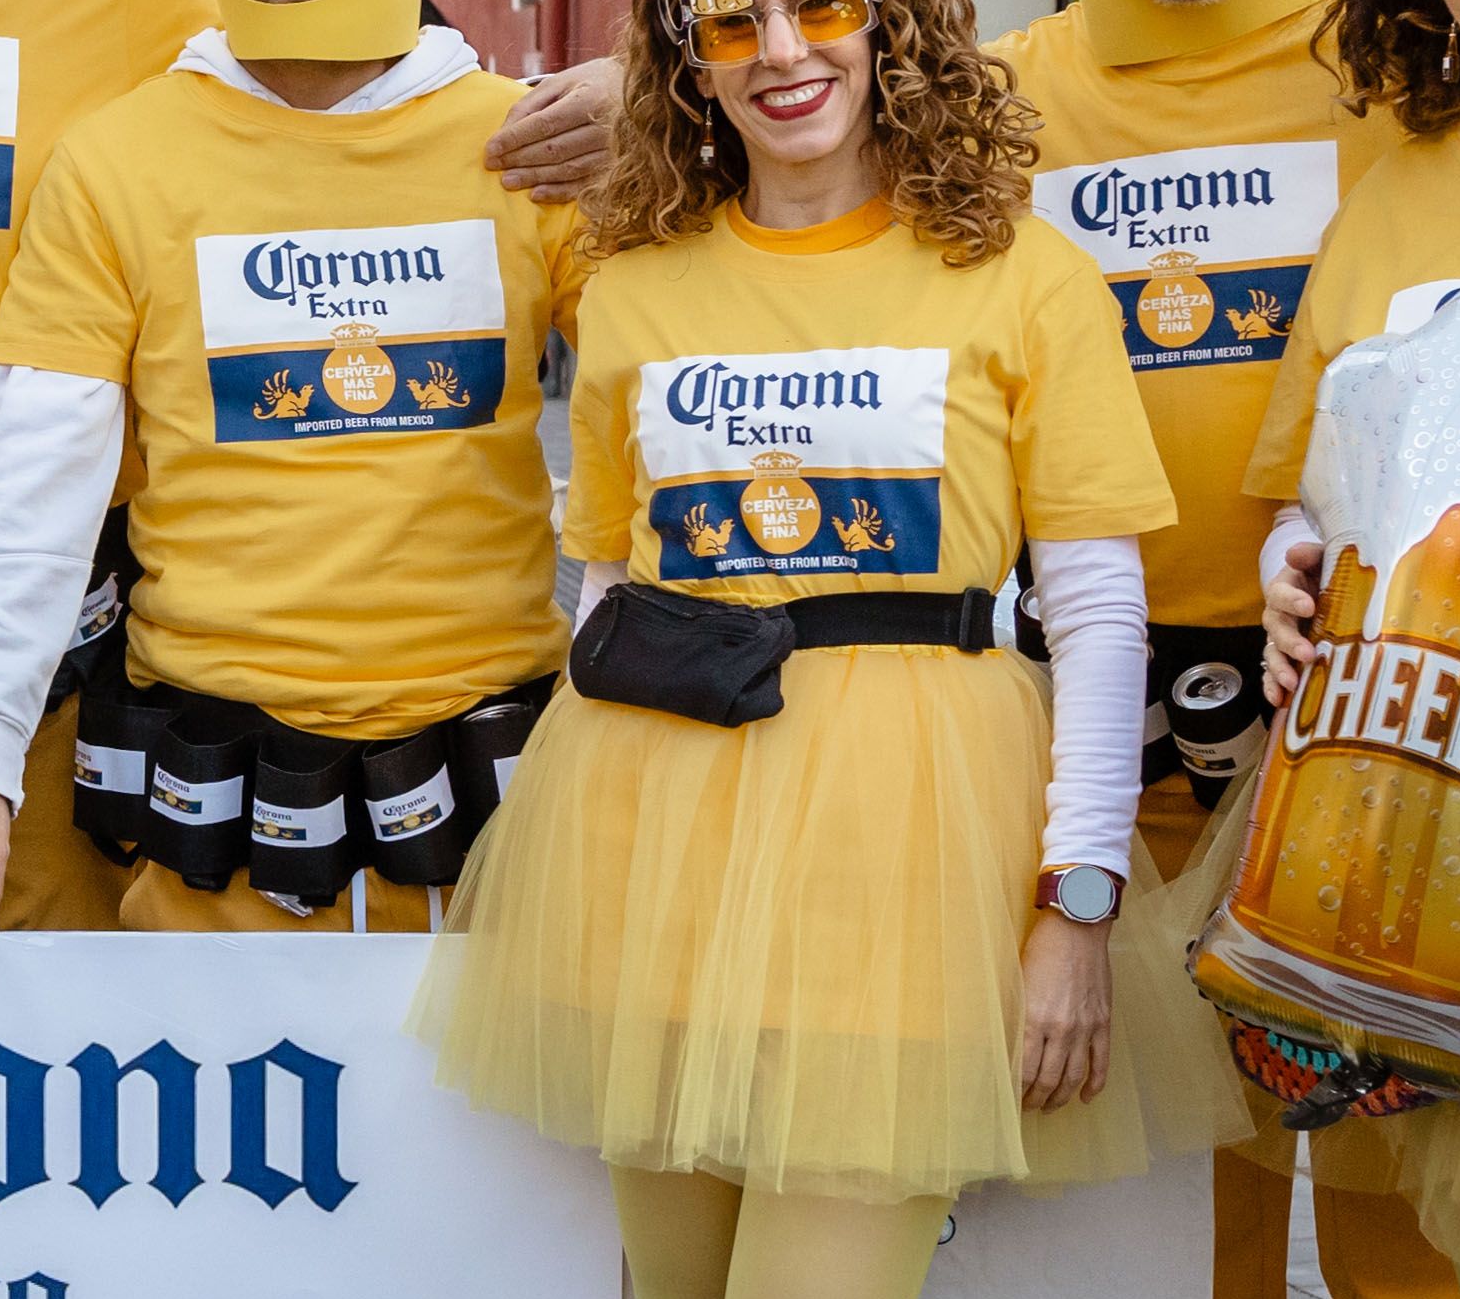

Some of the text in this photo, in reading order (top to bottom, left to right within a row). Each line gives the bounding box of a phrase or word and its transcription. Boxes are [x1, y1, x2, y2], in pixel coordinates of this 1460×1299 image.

[1071, 167, 1276, 237] Corona
[1126, 219, 1211, 250] Extra
[243, 239, 446, 307] Corona
[1164, 283, 1185, 297] LA
[306, 292, 389, 320] Extra
[1139, 295, 1211, 311] CERVEZA
[1158, 308, 1193, 322] MAS
[1157, 320, 1194, 334] FINA
[347, 354, 367, 366] LA
[1155, 351, 1182, 364] BEER
[1182, 348, 1213, 362] FROM
[1213, 345, 1253, 359] MEXICO
[324, 364, 392, 379] CERVEZA
[343, 377, 376, 390] MAS
[344, 389, 378, 402] FINA
[666, 361, 883, 432] Corona
[294, 414, 434, 434] IMPORTED BEER FROM MEXICO
[724, 414, 814, 446] Extra
[767, 485, 789, 499] LA
[742, 498, 817, 514] CERVEZA
[762, 511, 799, 526] MAS
[762, 525, 801, 539] FINA
[714, 558, 766, 573] IMPORTED
[789, 556, 820, 569] FROM
[382, 795, 427, 817] Corona
